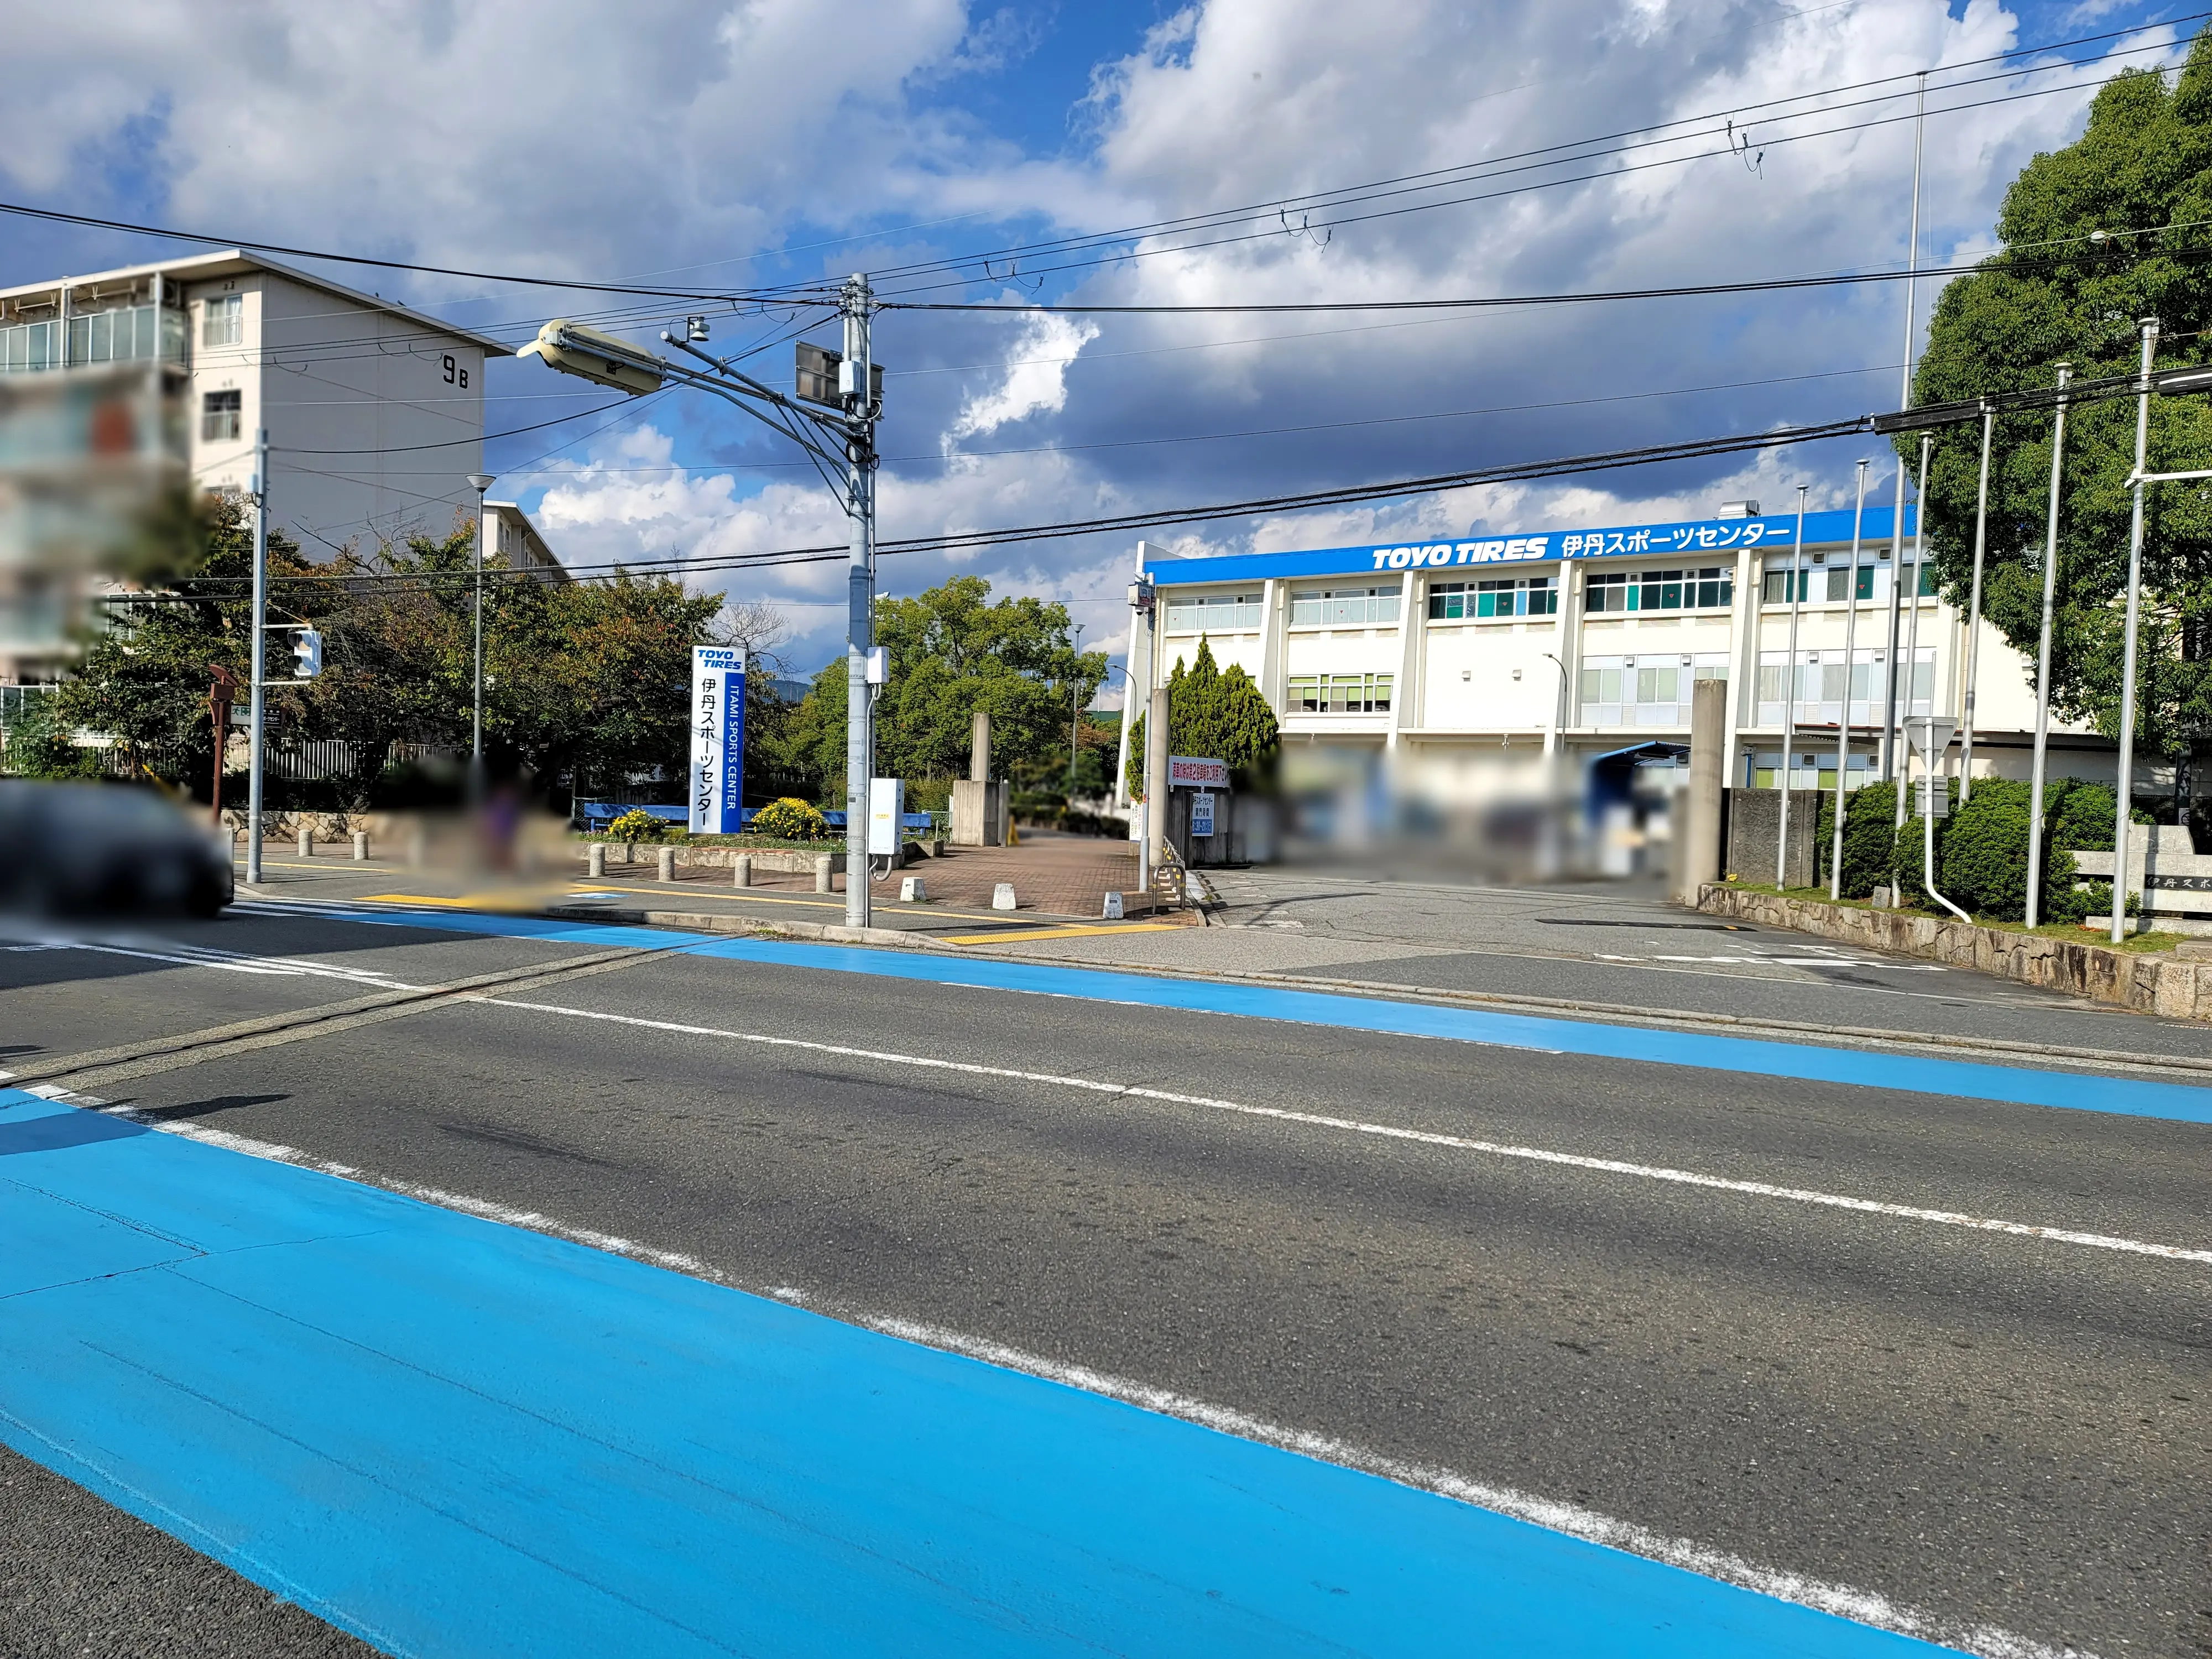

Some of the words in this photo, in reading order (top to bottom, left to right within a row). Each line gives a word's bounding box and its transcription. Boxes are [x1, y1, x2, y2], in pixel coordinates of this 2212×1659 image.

[1373, 544, 1453, 569] TOYO
[1455, 537, 1549, 564] TIRES
[1561, 523, 1790, 557] 伊丹スポーツセンター
[698, 649, 734, 660] TOYO
[703, 659, 742, 670] TIRES
[729, 685, 739, 718] ITAMI
[697, 678, 717, 826] 伊丹スポーツセンター
[728, 721, 738, 763] SPORTS
[727, 766, 738, 810] CENTER
[2147, 877, 2211, 889] 伊丹スポ
